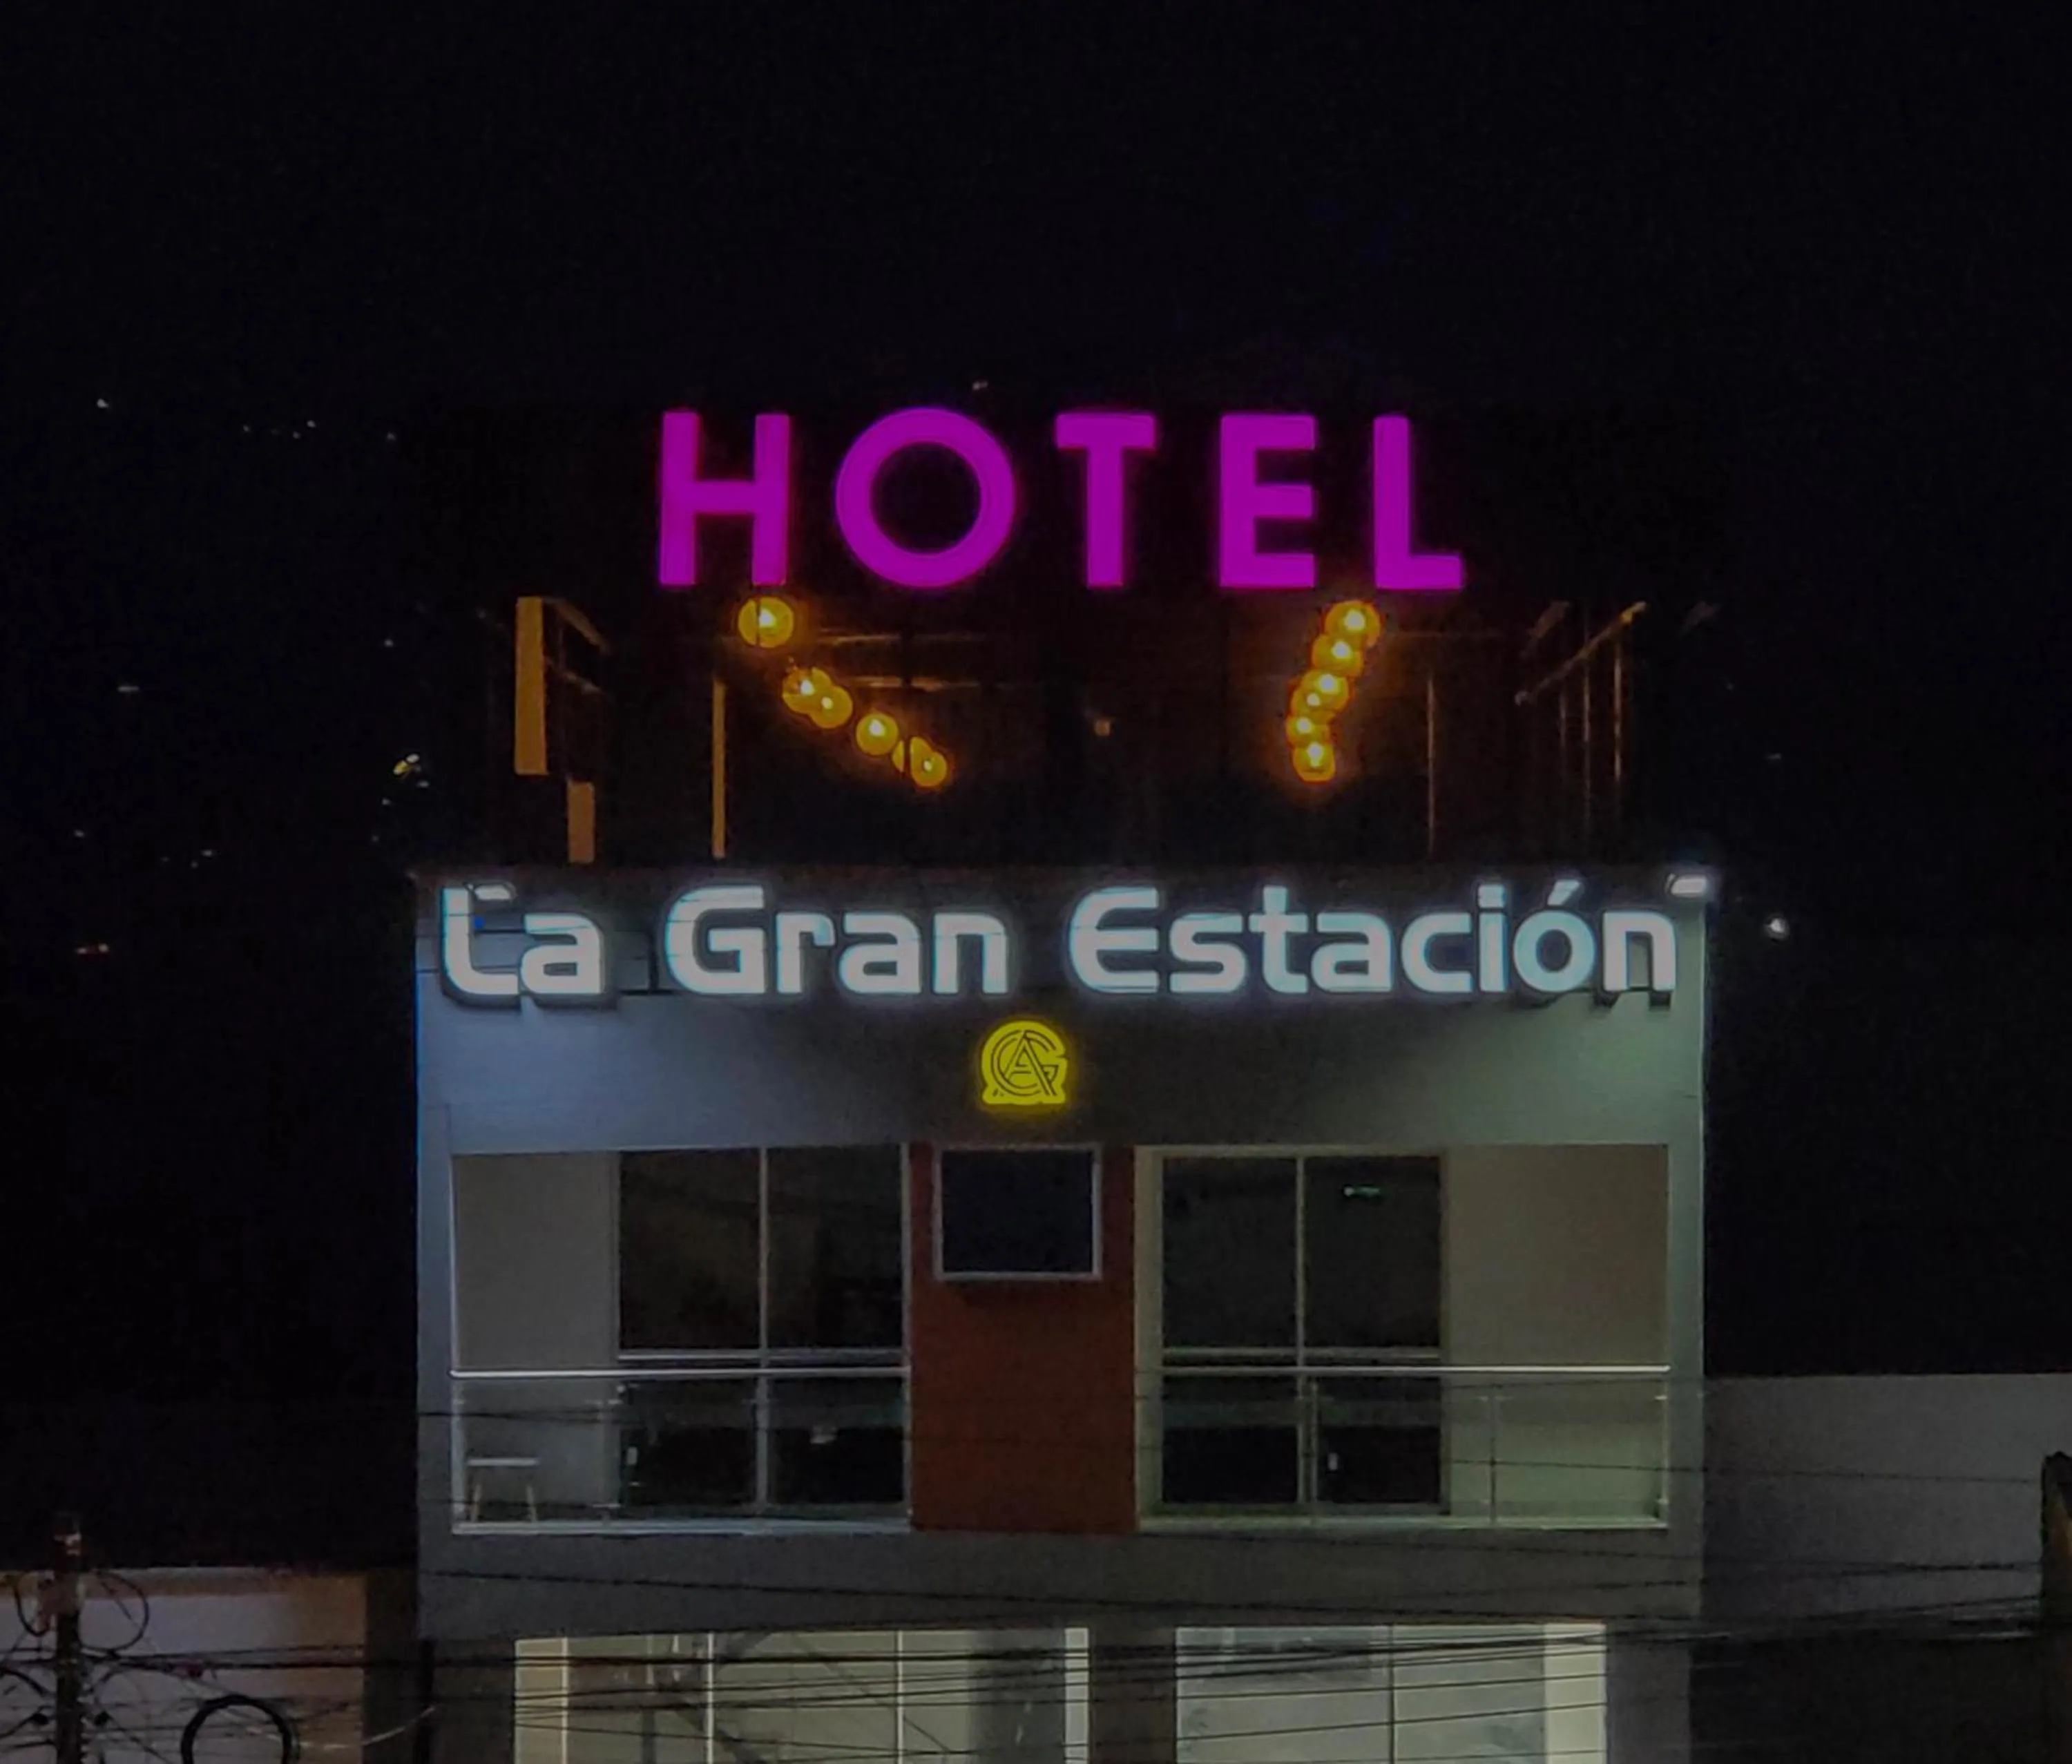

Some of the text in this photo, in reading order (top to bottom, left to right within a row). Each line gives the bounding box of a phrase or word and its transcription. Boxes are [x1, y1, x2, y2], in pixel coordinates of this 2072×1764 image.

[659, 408, 1462, 590] HOTEL
[440, 878, 1678, 996] La Gran Estación
